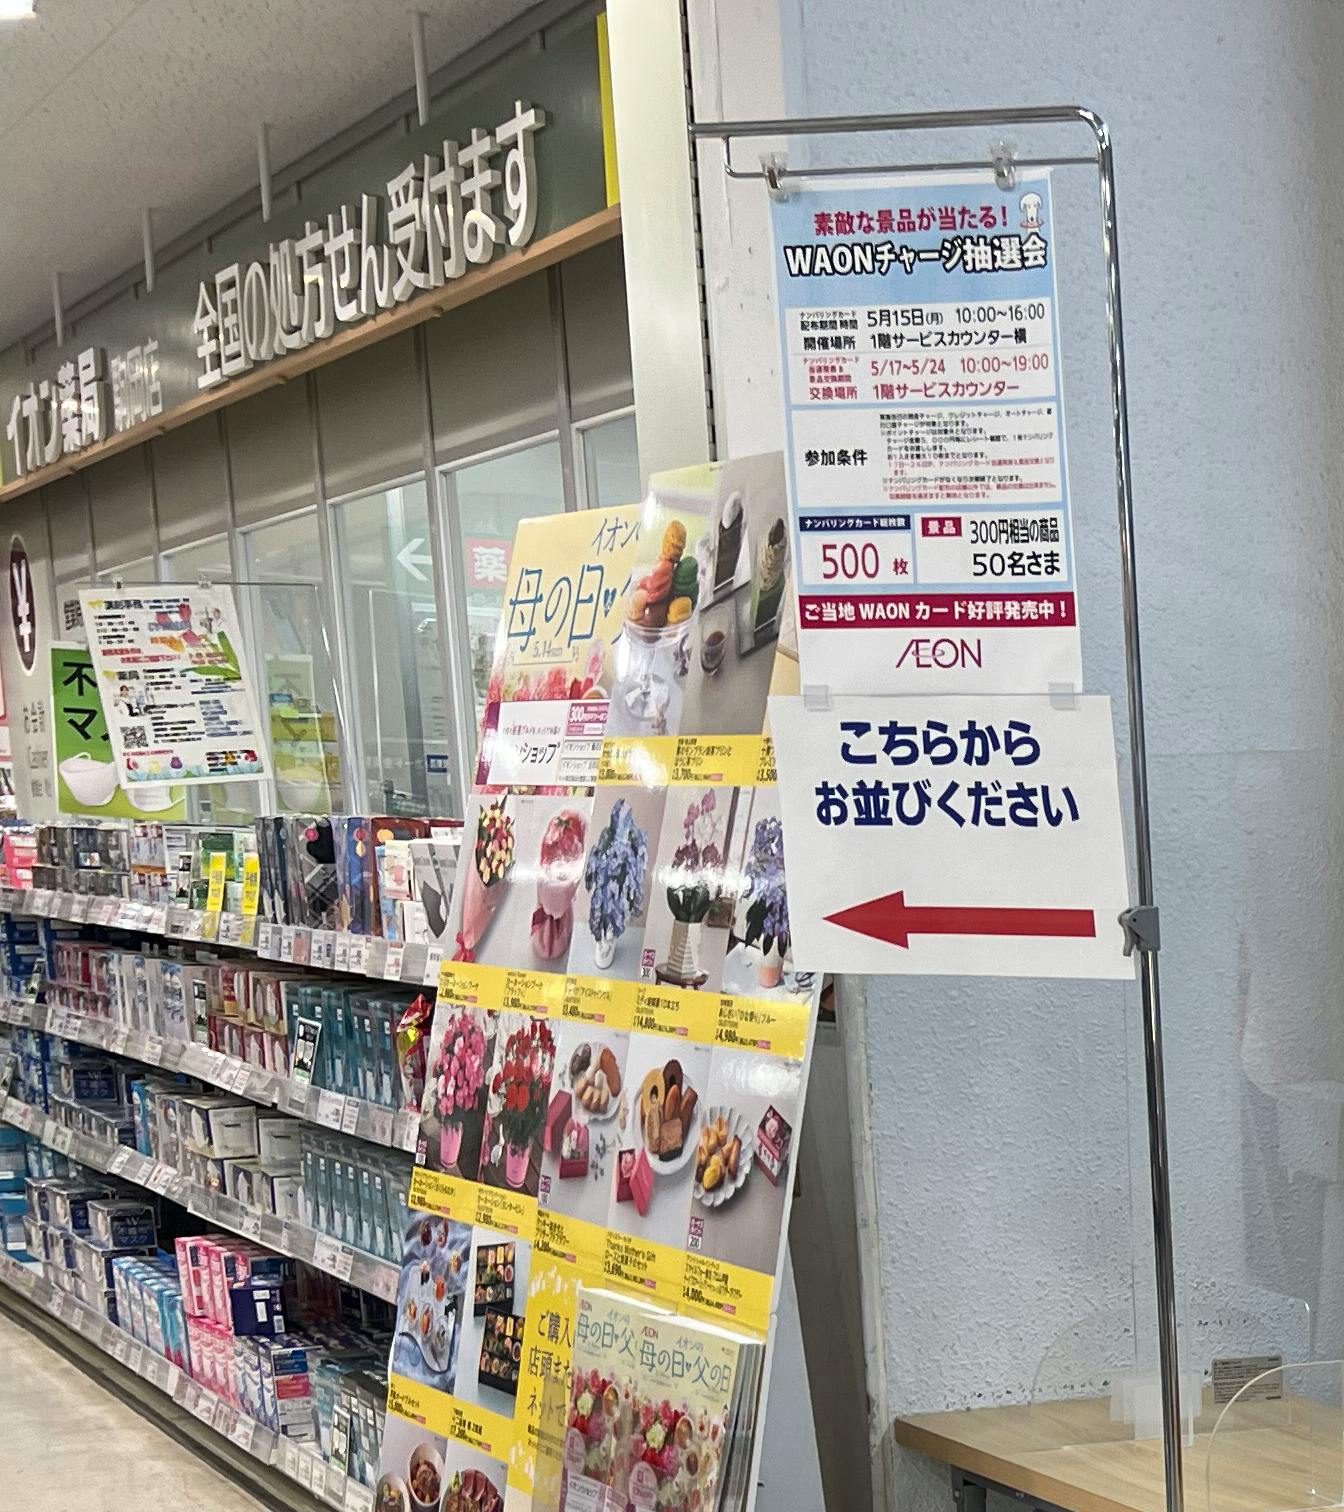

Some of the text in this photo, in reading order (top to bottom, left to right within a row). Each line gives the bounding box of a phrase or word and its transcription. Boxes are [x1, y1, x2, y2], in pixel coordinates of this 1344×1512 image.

[194, 100, 546, 390] 全国の処方せん受付ます
[783, 231, 1049, 277] WAONチャージ抽選会
[6, 347, 104, 476] イオン薬局
[804, 449, 868, 467] 参加条件
[927, 520, 957, 535] 景品
[821, 542, 880, 579] 500
[971, 550, 1061, 577] 50名さま
[804, 603, 856, 622] ご当地
[858, 602, 910, 620] WAON
[839, 720, 1041, 766] こちらから
[814, 780, 1080, 828] お並びください
